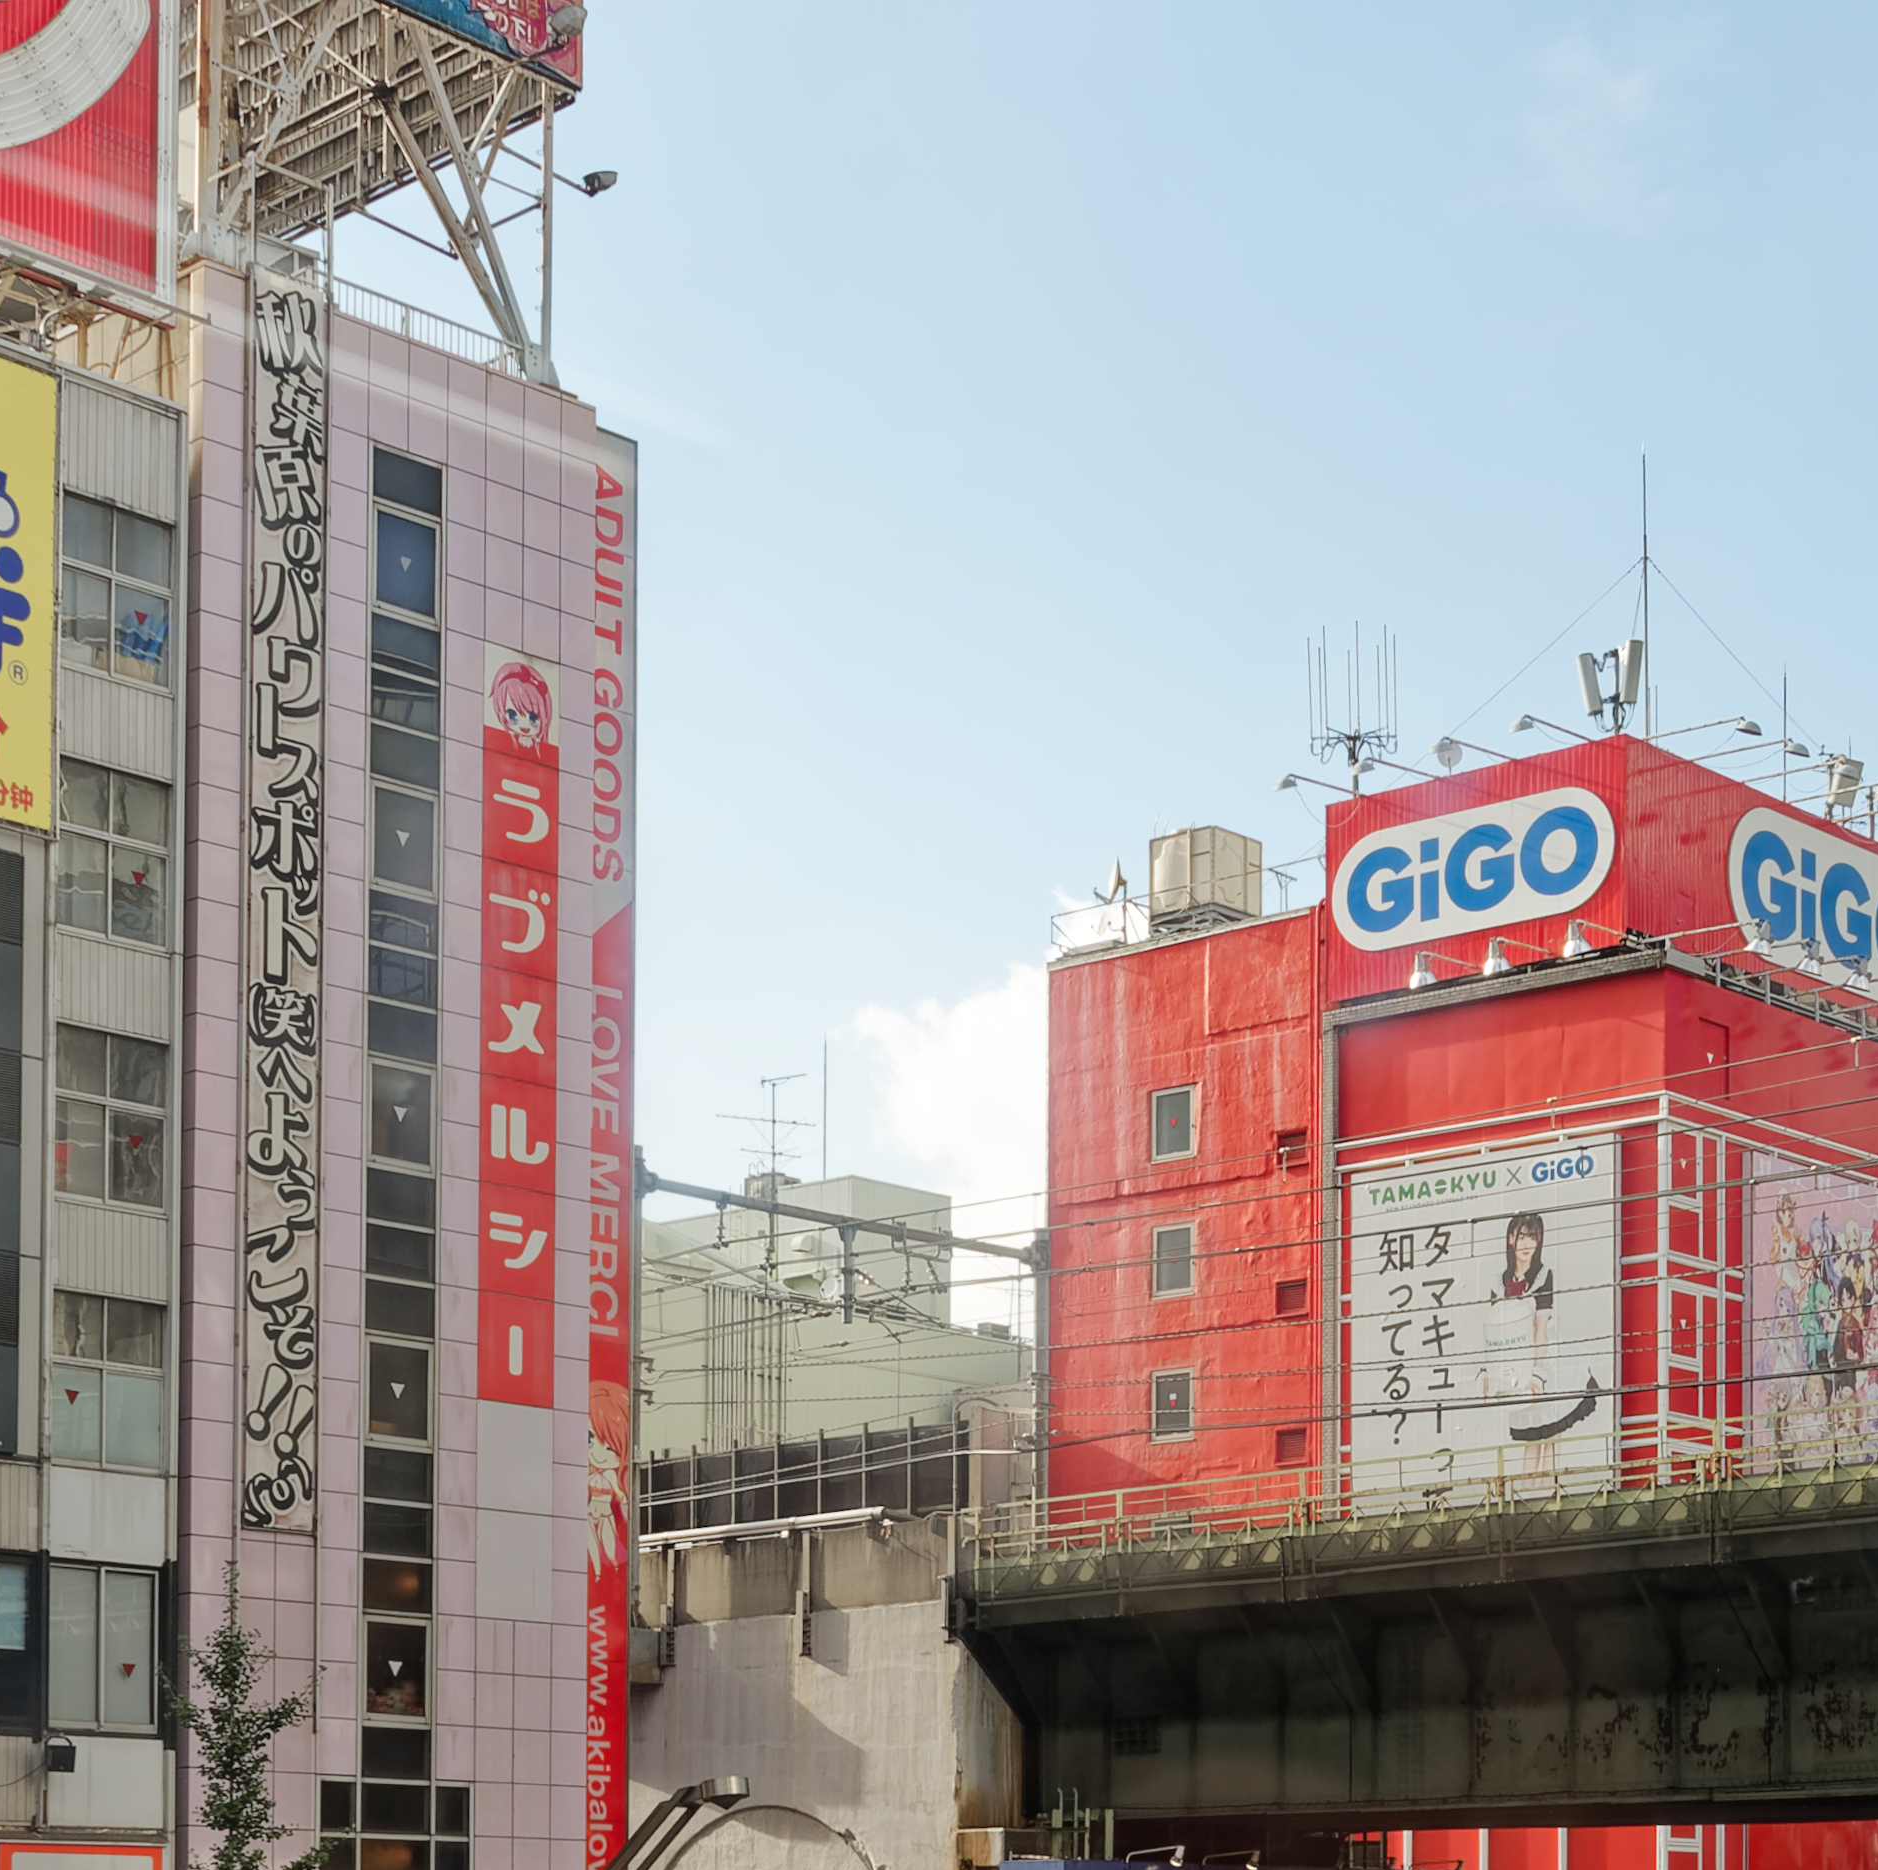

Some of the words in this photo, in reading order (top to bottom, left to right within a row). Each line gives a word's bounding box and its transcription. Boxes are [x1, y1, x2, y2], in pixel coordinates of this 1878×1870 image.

[594, 463, 624, 655] ADULT
[593, 667, 623, 883] GOODS
[487, 778, 551, 1376] ラブメルシー
[592, 984, 623, 1135] LOVE
[588, 1155, 620, 1338] MERCI
